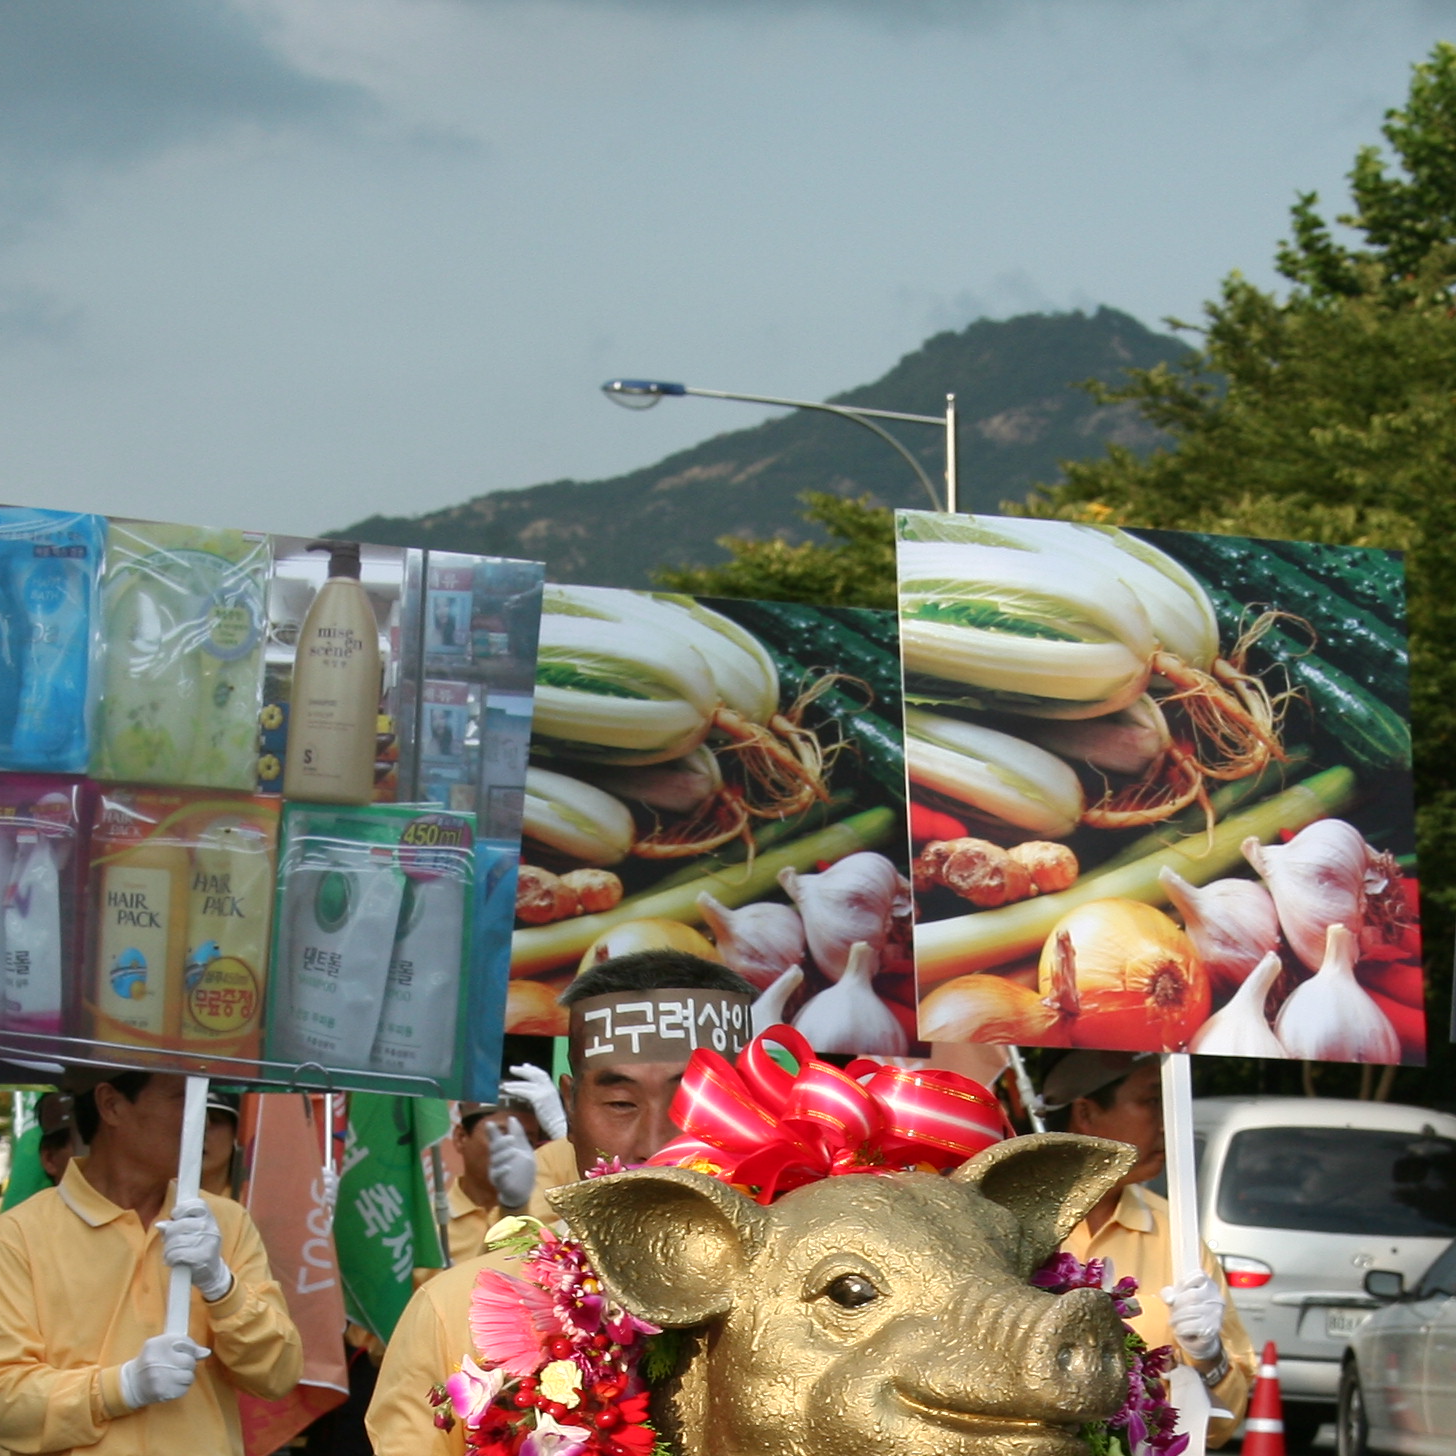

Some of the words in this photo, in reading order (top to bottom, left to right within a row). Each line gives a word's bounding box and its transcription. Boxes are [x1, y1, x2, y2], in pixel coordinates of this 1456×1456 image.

[318, 627, 354, 639] mise
[345, 637, 362, 651] en
[193, 871, 232, 894] HAIR
[107, 890, 149, 911] HAIR
[202, 895, 245, 919] PACK
[117, 910, 161, 929] PACK
